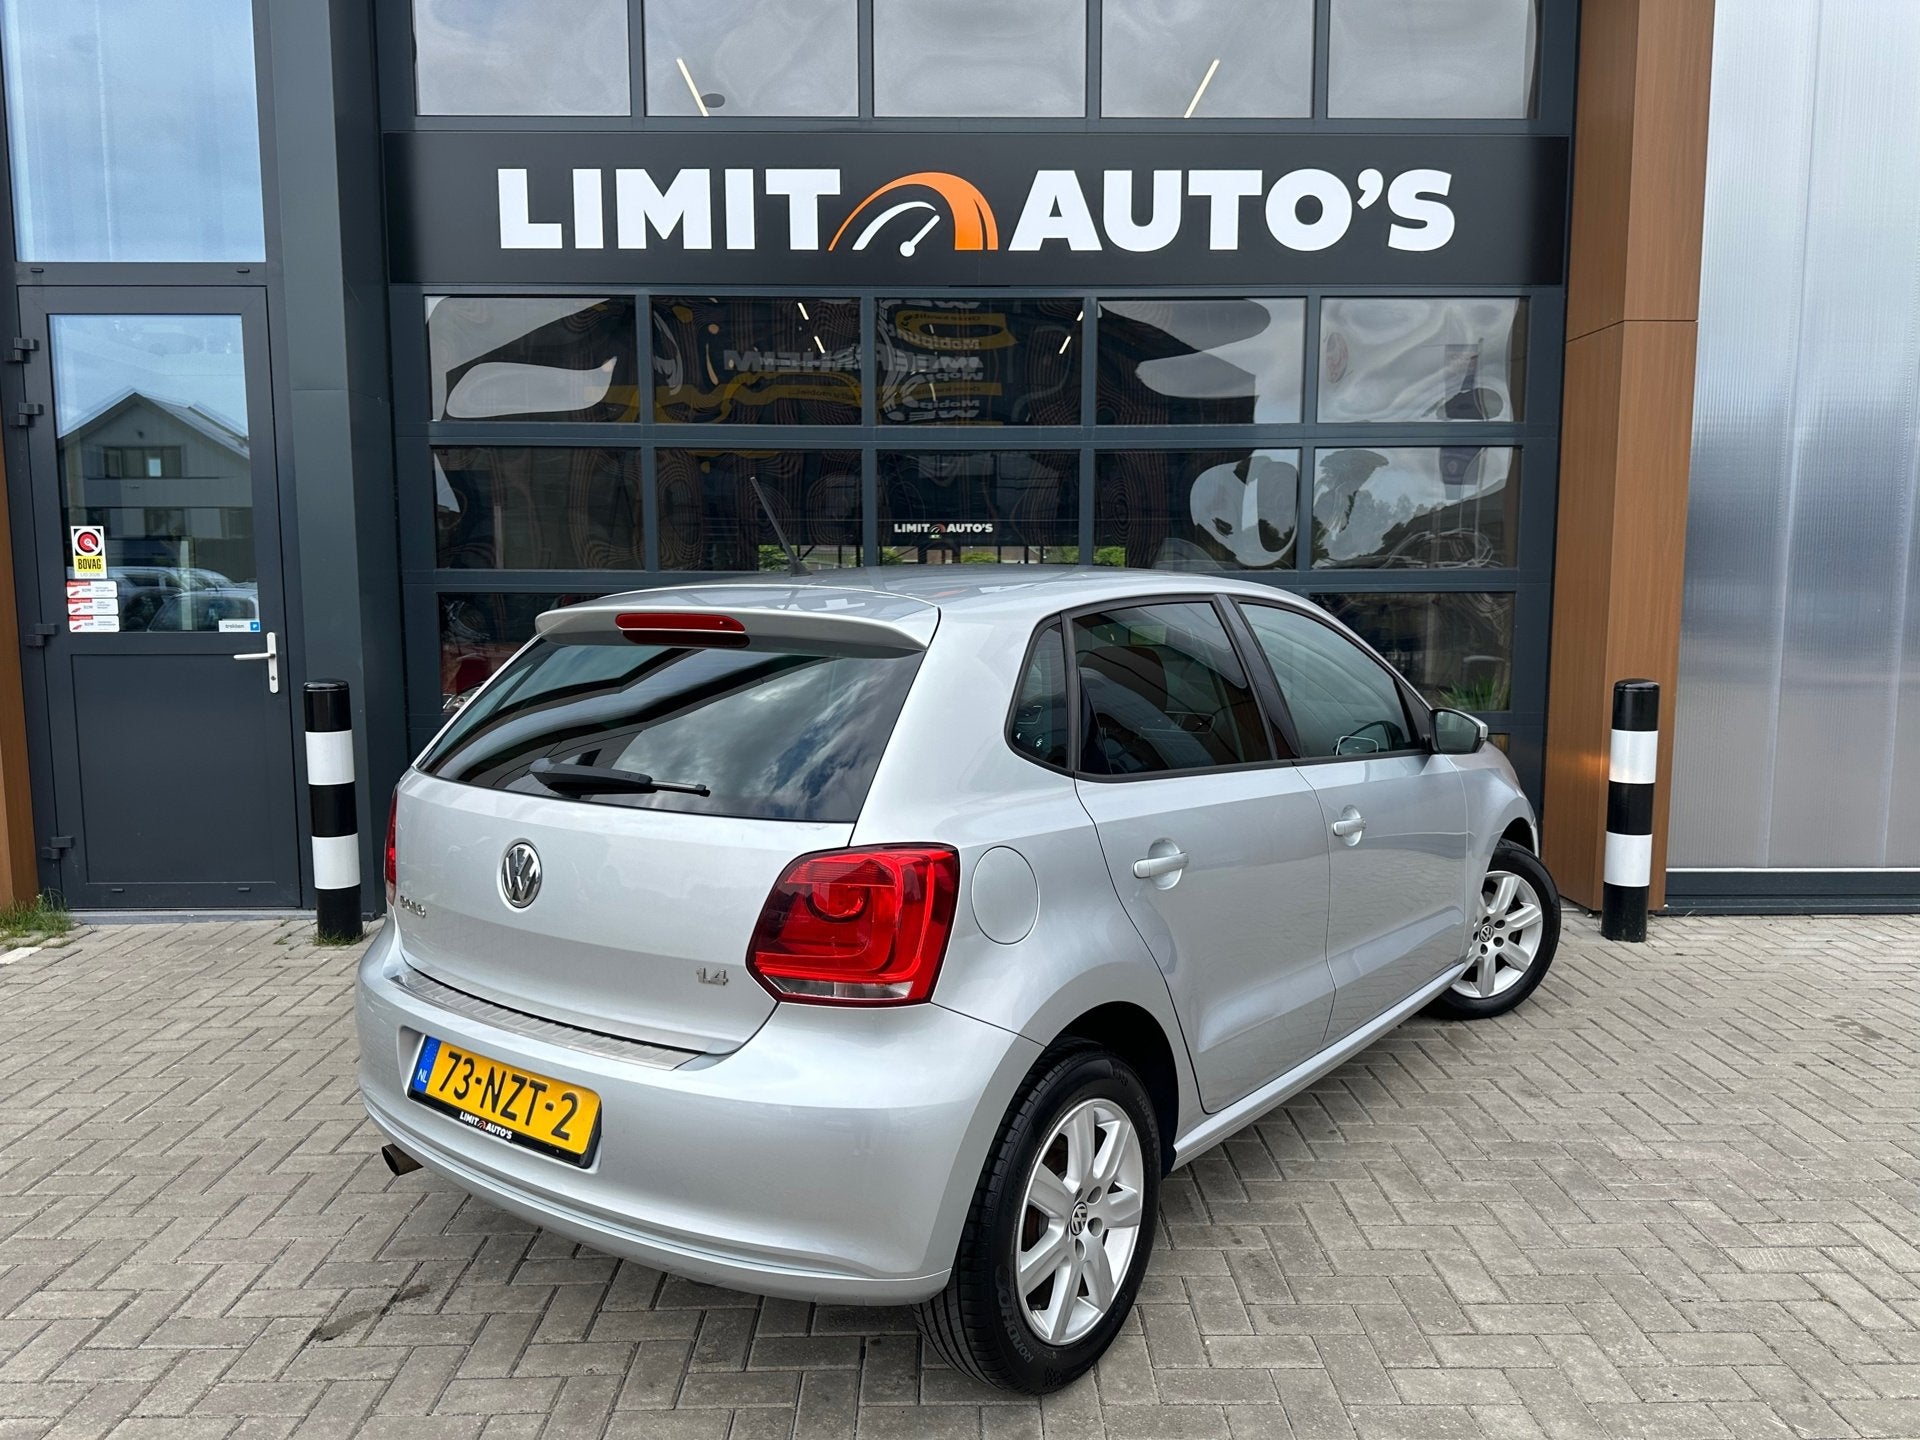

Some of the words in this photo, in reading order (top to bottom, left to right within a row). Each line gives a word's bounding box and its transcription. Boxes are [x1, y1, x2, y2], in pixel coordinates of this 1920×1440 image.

[497, 168, 841, 251] LIMIT
[1006, 168, 1456, 252] AUTO'S
[893, 523, 931, 533] LIMIT
[946, 523, 994, 533] AUTO'S
[77, 558, 102, 570] BOVAG
[416, 1068, 428, 1085] NL
[438, 1051, 579, 1141] 73-NZT-2
[459, 1110, 480, 1127] LIMIT
[486, 1122, 513, 1140] AUTO'S
